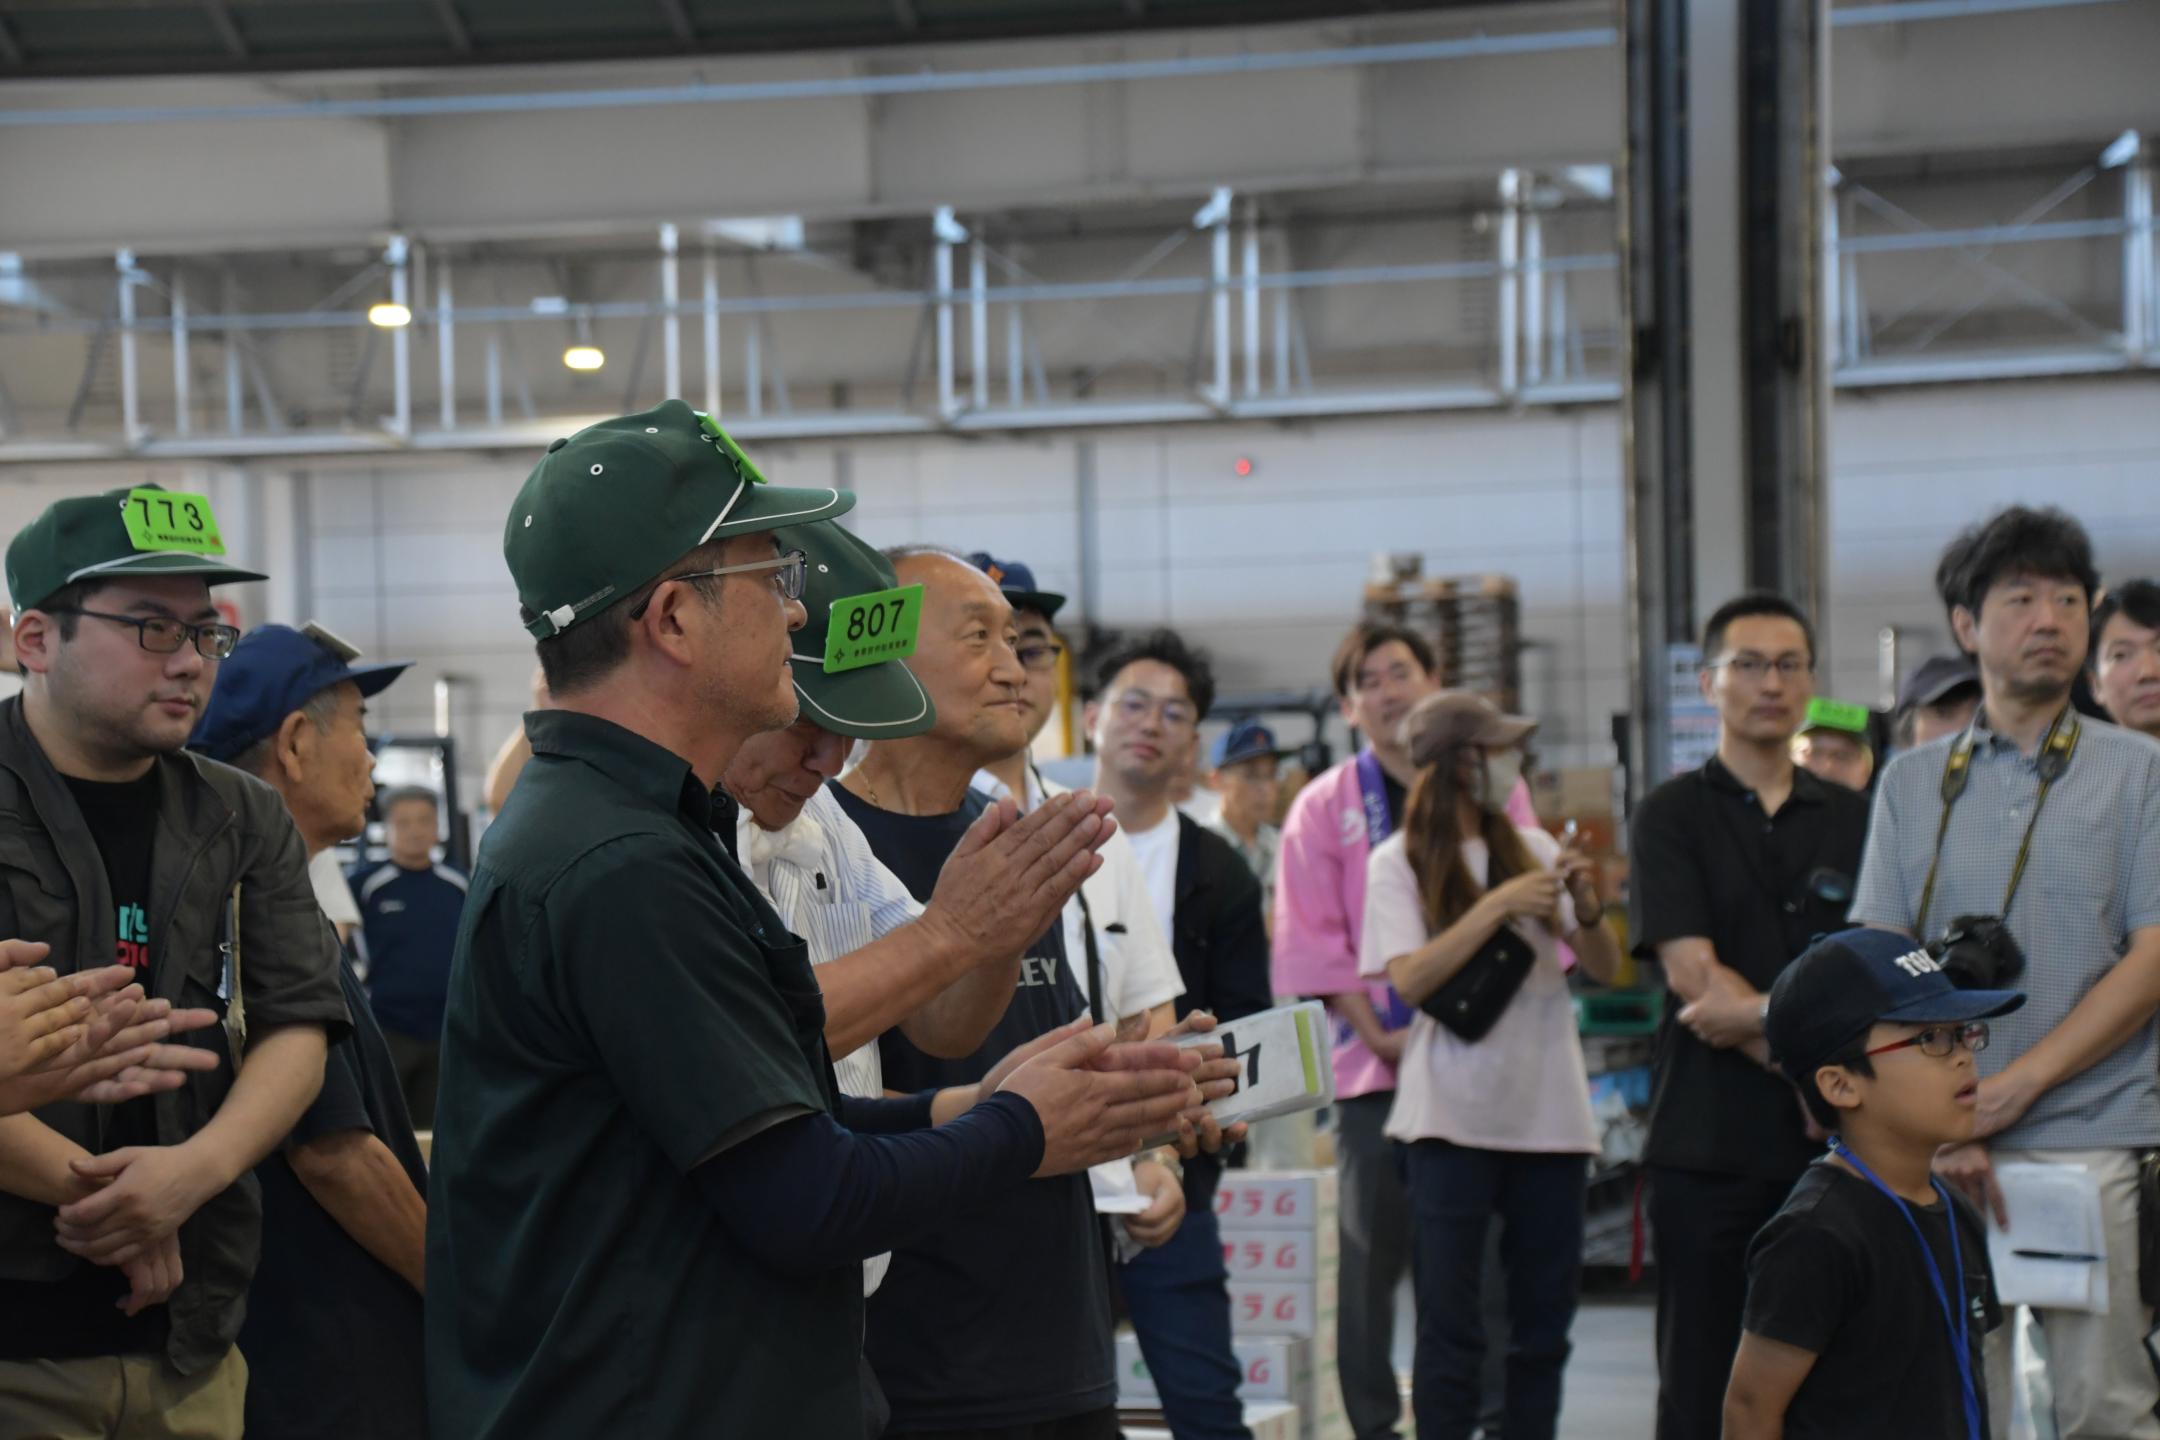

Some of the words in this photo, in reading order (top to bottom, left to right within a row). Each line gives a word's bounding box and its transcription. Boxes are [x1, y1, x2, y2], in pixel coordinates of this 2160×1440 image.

[132, 497, 204, 531] 773
[847, 598, 906, 641] 807
[1017, 957, 1057, 987] EY
